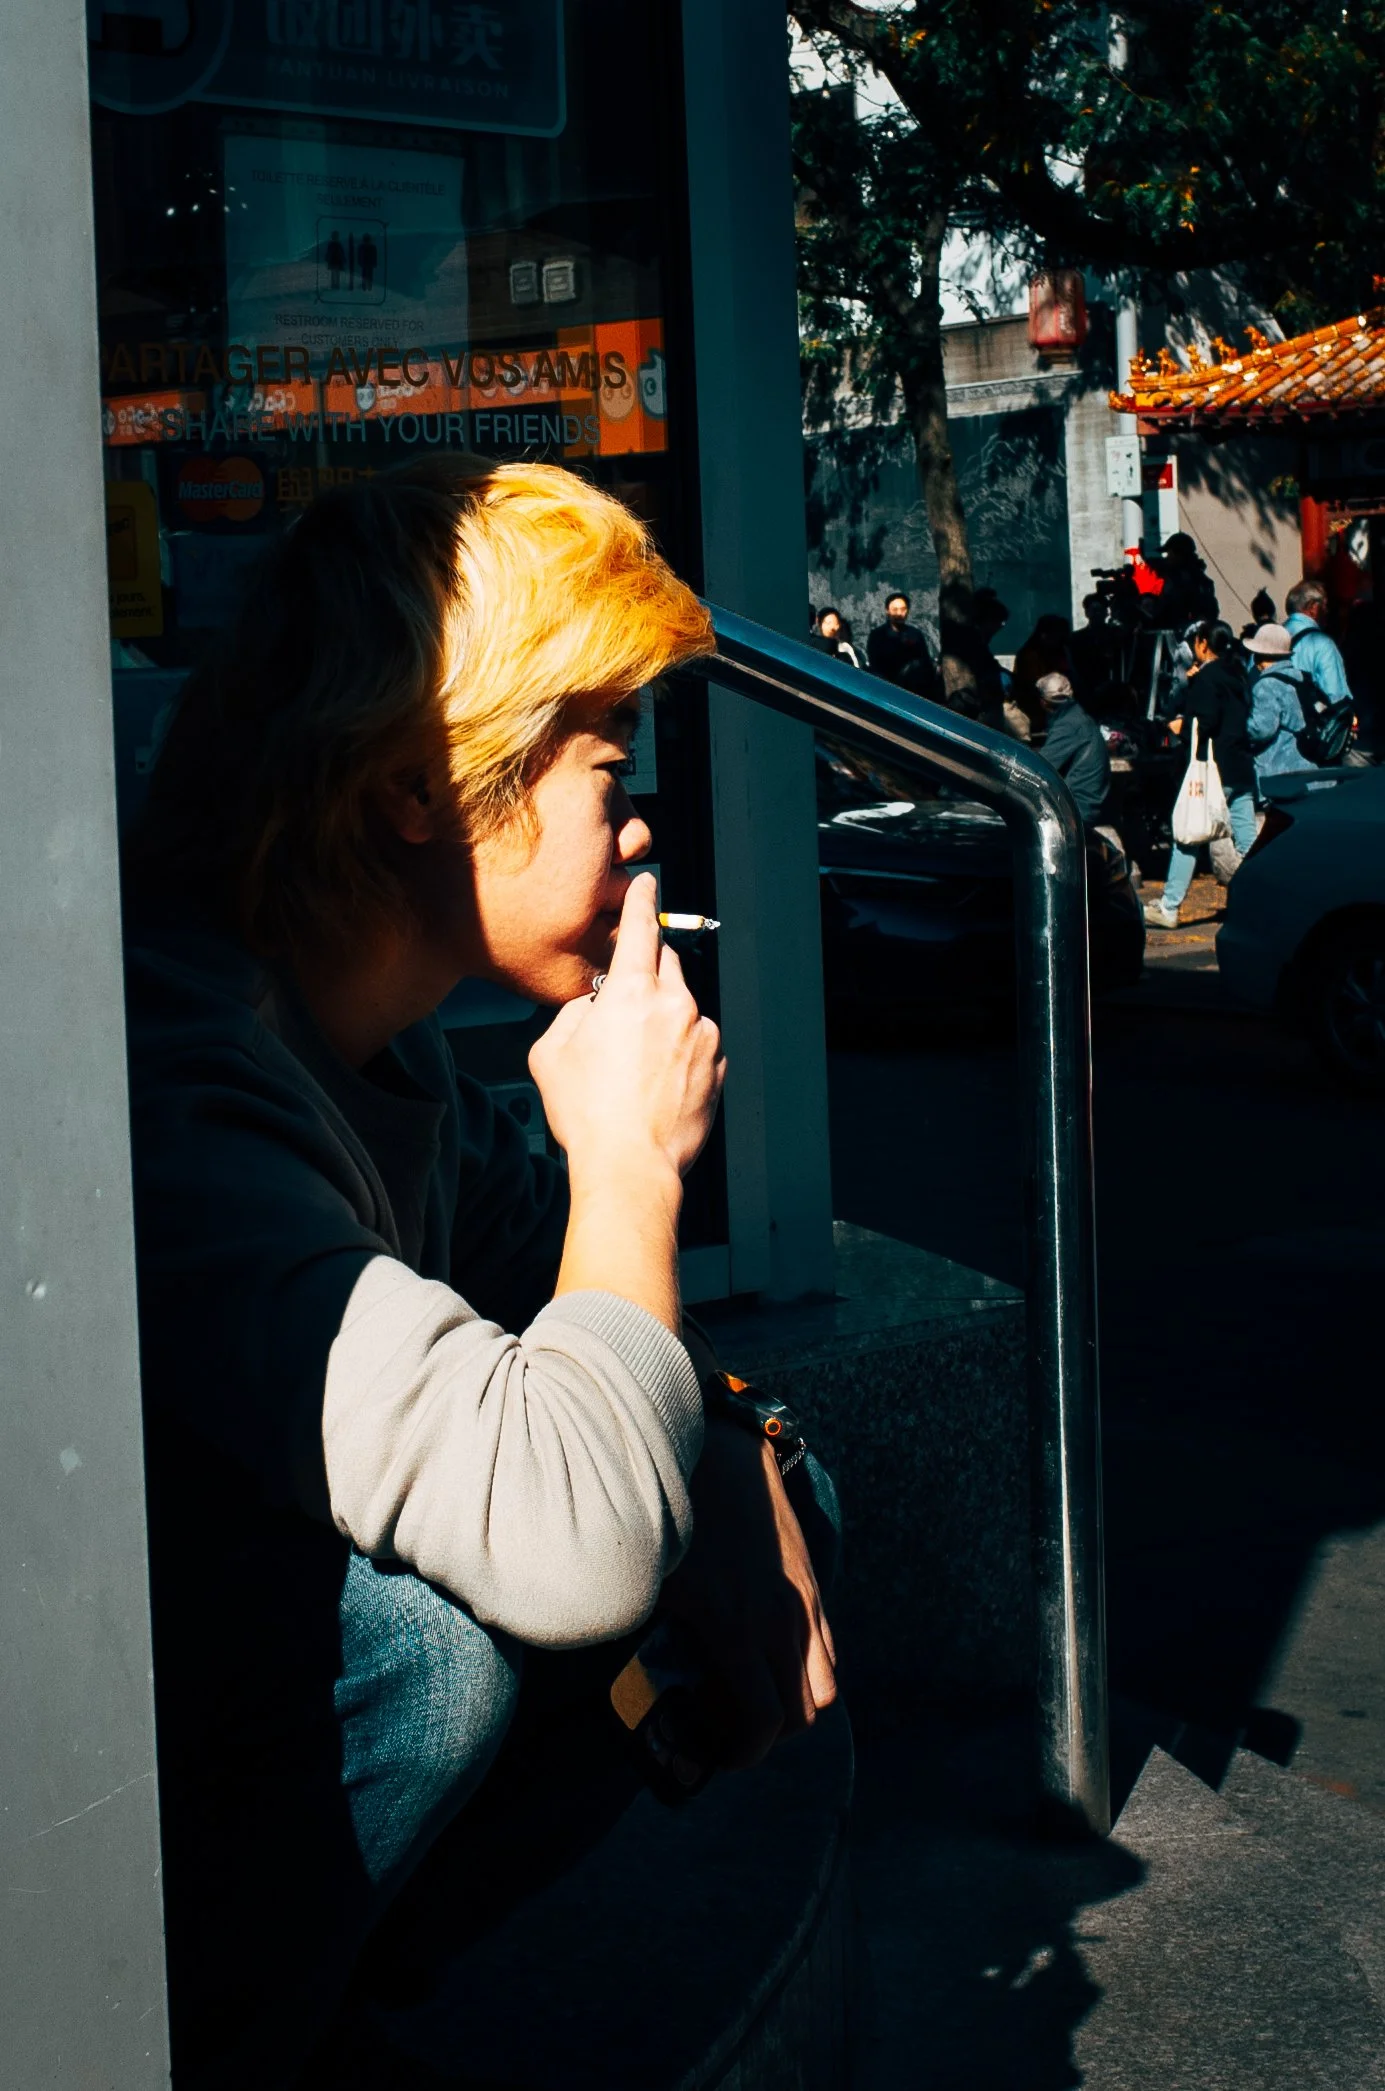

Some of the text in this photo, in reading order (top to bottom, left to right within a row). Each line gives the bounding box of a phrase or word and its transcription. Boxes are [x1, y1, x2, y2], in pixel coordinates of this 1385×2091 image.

[387, 69, 509, 98] LIVRAISON
[252, 169, 304, 185] TOILETTE
[275, 314, 425, 331] RESTROOM RESERVED FOR
[301, 333, 369, 347] CUSTOMERS
[324, 347, 431, 388] AVEC
[440, 348, 522, 389] VOS
[532, 350, 627, 391] AMIS
[159, 411, 277, 442] SHARE
[285, 412, 370, 443] WITH
[378, 413, 466, 444] YOUR
[475, 414, 601, 446] FRIENDS
[178, 480, 264, 501] MasterCard
